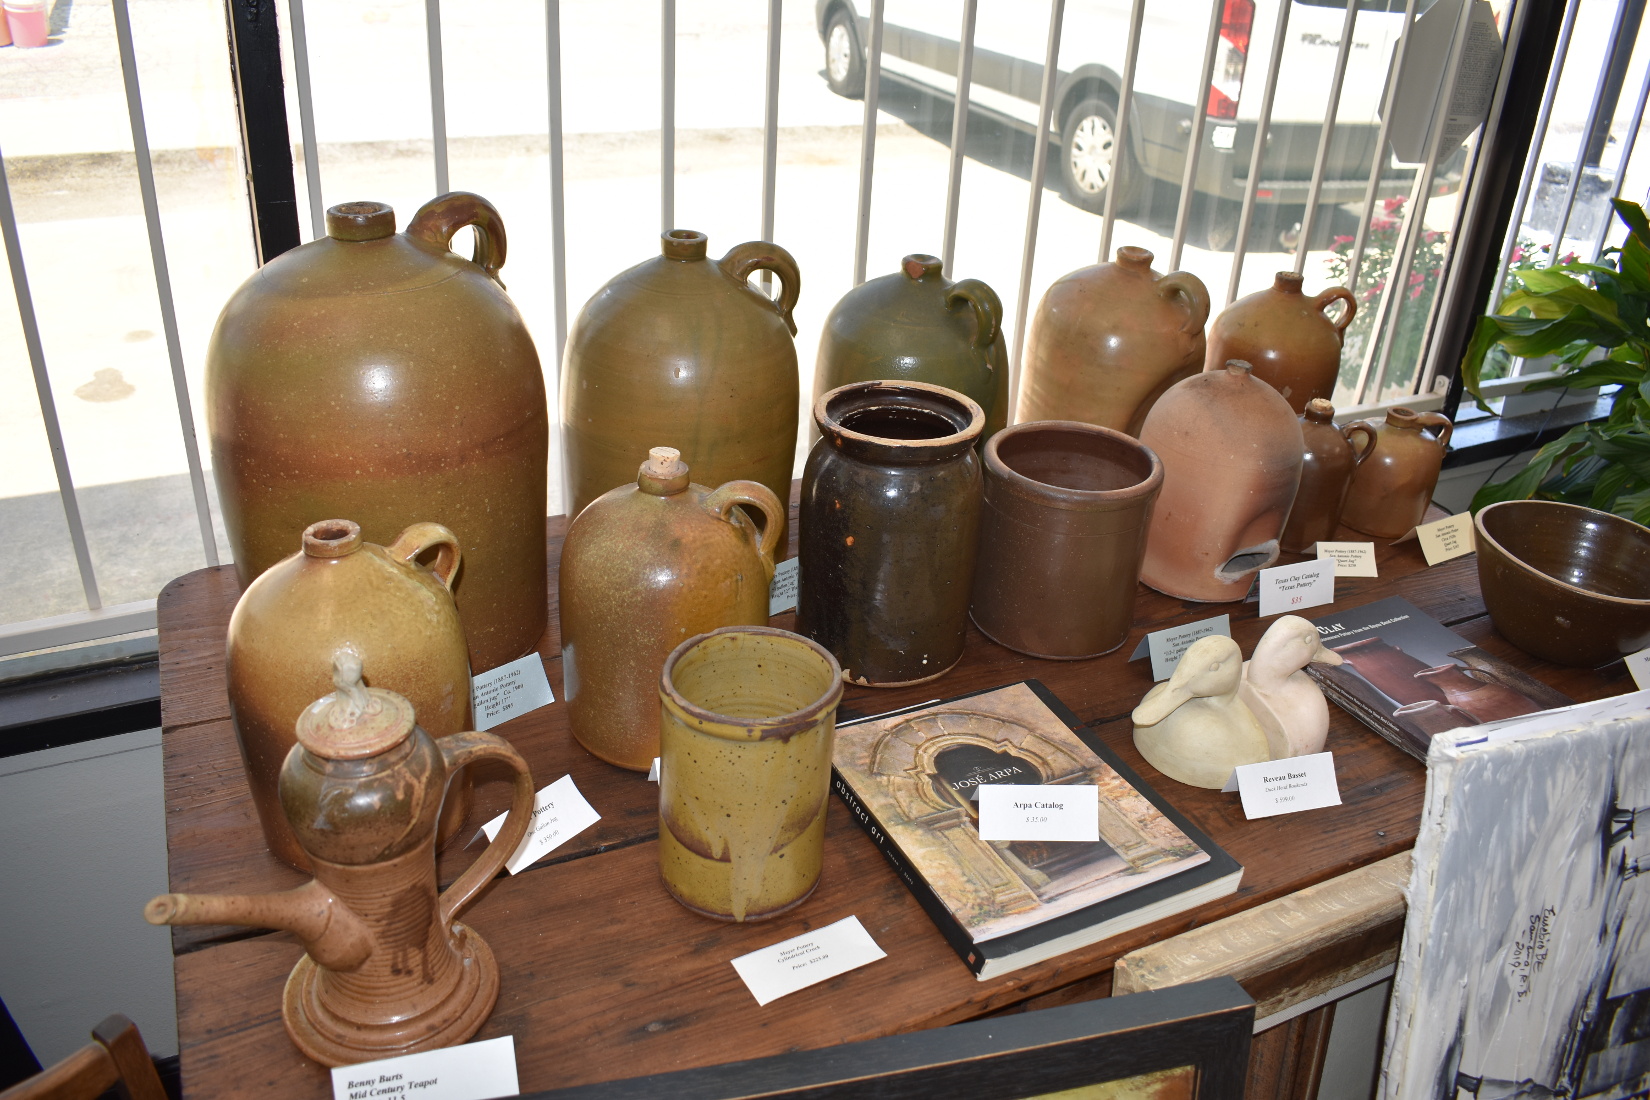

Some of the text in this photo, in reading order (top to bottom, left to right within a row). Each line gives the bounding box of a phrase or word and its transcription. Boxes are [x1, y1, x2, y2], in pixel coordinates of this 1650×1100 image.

[1275, 572, 1320, 585] Texas Clay Catalog
[1291, 596, 1302, 604] $35
[952, 774, 987, 791] JOSÉ
[988, 766, 1023, 781] ARPA
[1263, 772, 1306, 783] Reveau Basset
[532, 801, 555, 818] Pottery
[836, 780, 869, 825] abstract
[871, 826, 884, 844] art
[1034, 802, 1064, 810] Catalog
[348, 1073, 403, 1089] Benny Burts
[349, 1077, 438, 1100] Mid Century Teapot
